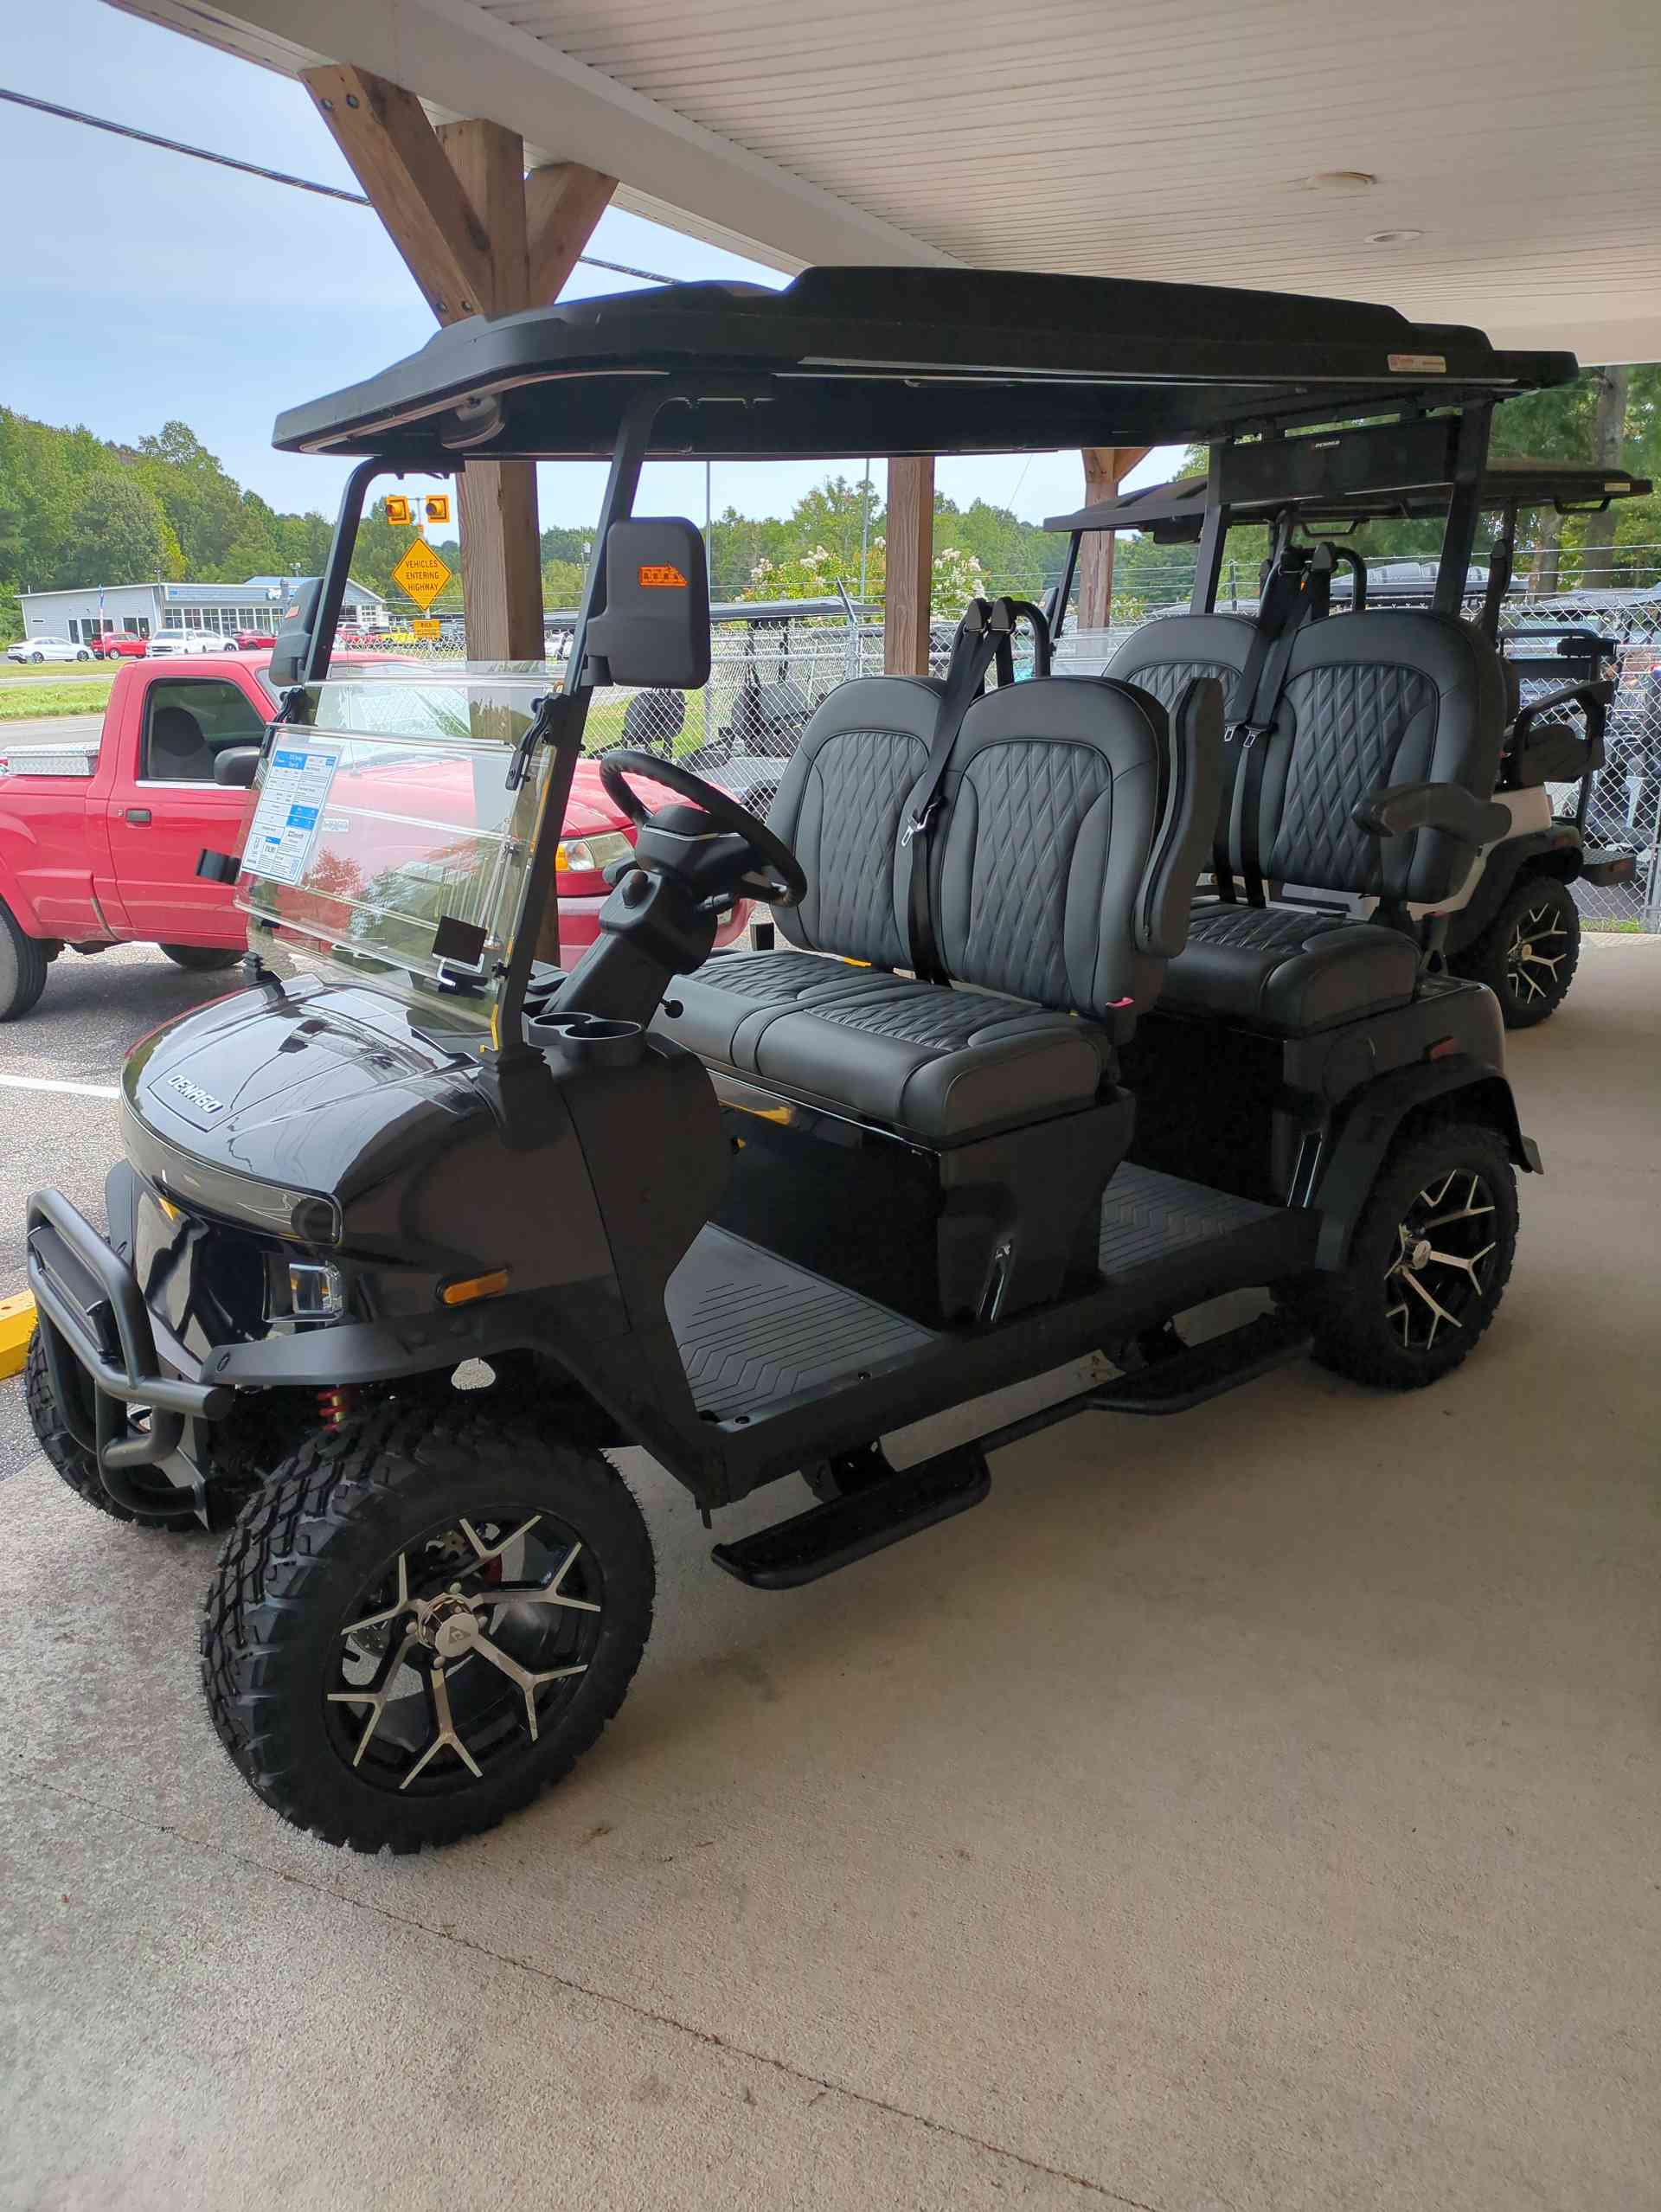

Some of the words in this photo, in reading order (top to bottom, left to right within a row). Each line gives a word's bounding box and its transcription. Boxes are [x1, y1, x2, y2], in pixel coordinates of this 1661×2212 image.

[406, 560, 438, 568] VEHICLES
[406, 571, 439, 580] ENTERING
[167, 1074, 223, 1113] DENAGO
